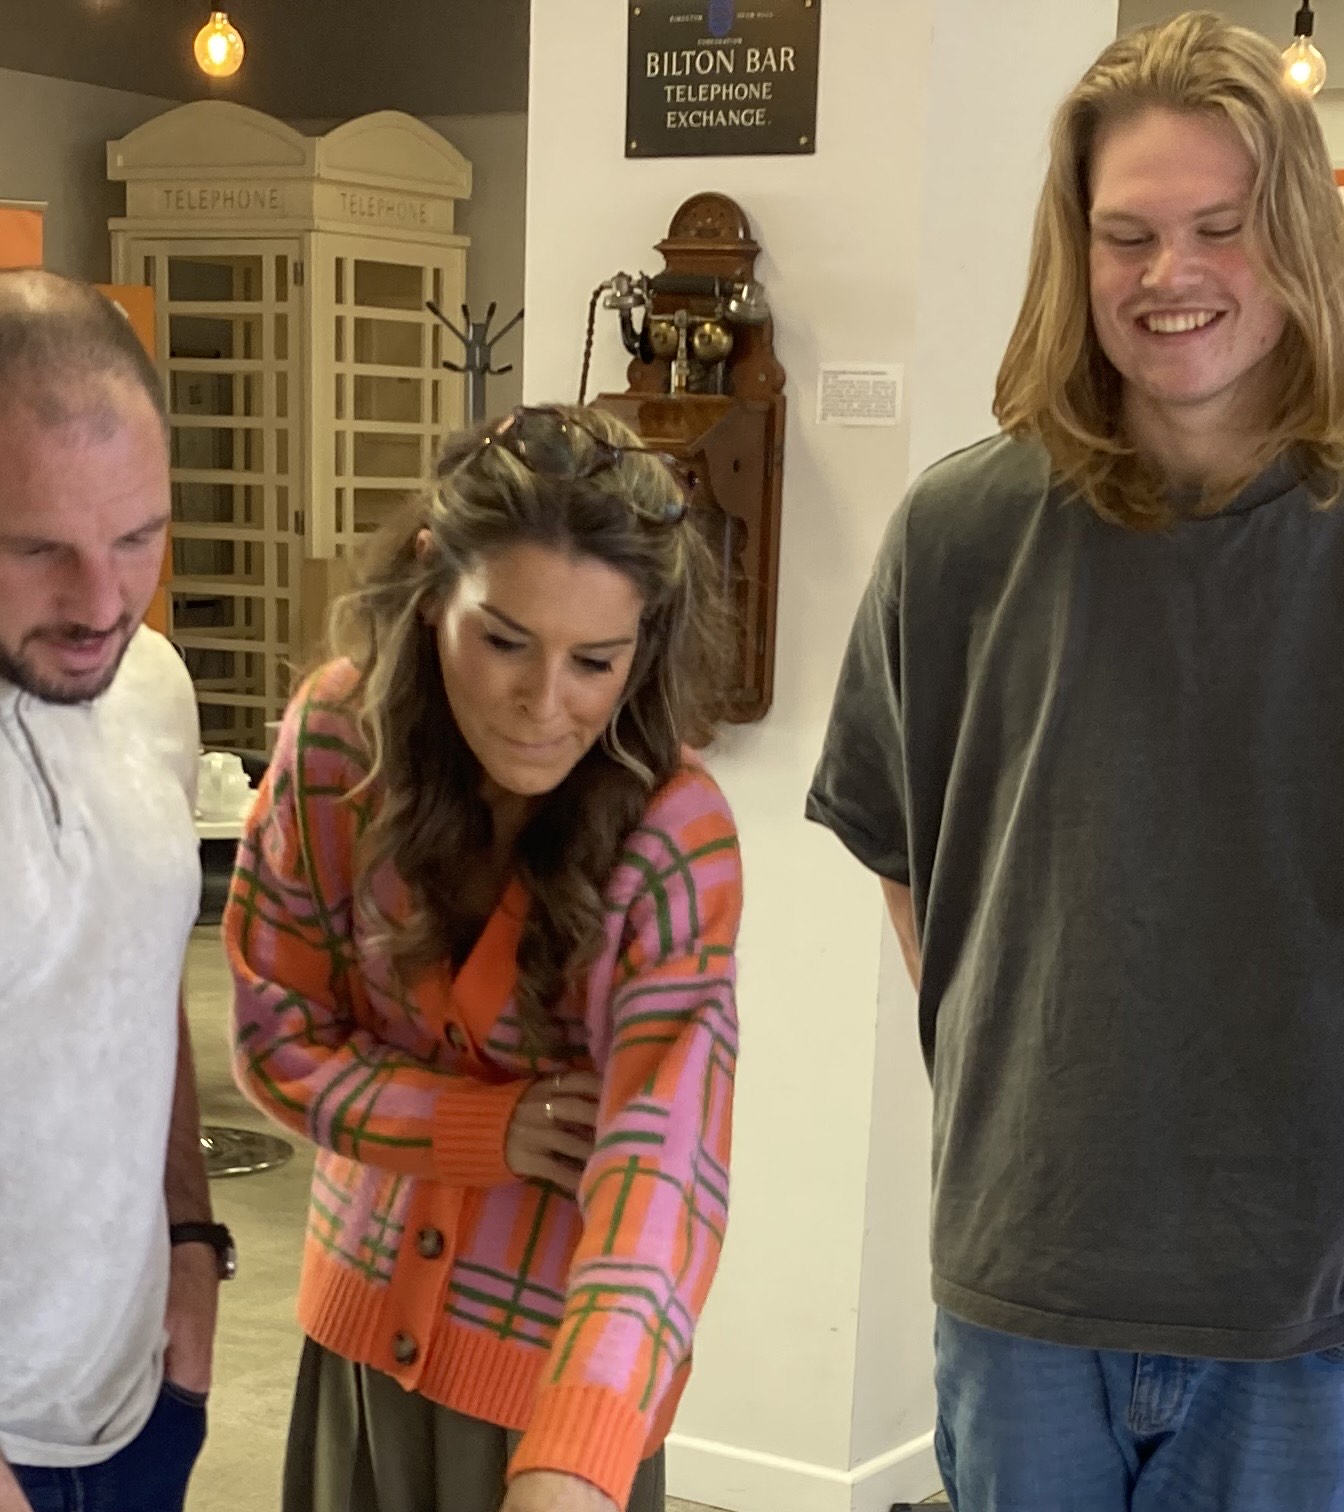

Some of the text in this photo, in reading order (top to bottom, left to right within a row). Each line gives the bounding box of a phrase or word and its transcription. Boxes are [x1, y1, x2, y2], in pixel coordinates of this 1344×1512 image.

[646, 47, 795, 78] BILTON BAR
[664, 82, 772, 102] TELEPHONE
[667, 108, 772, 128] EXCHANGE.
[164, 189, 279, 210] TELEPHONE
[340, 192, 428, 224] TELEPHONE
